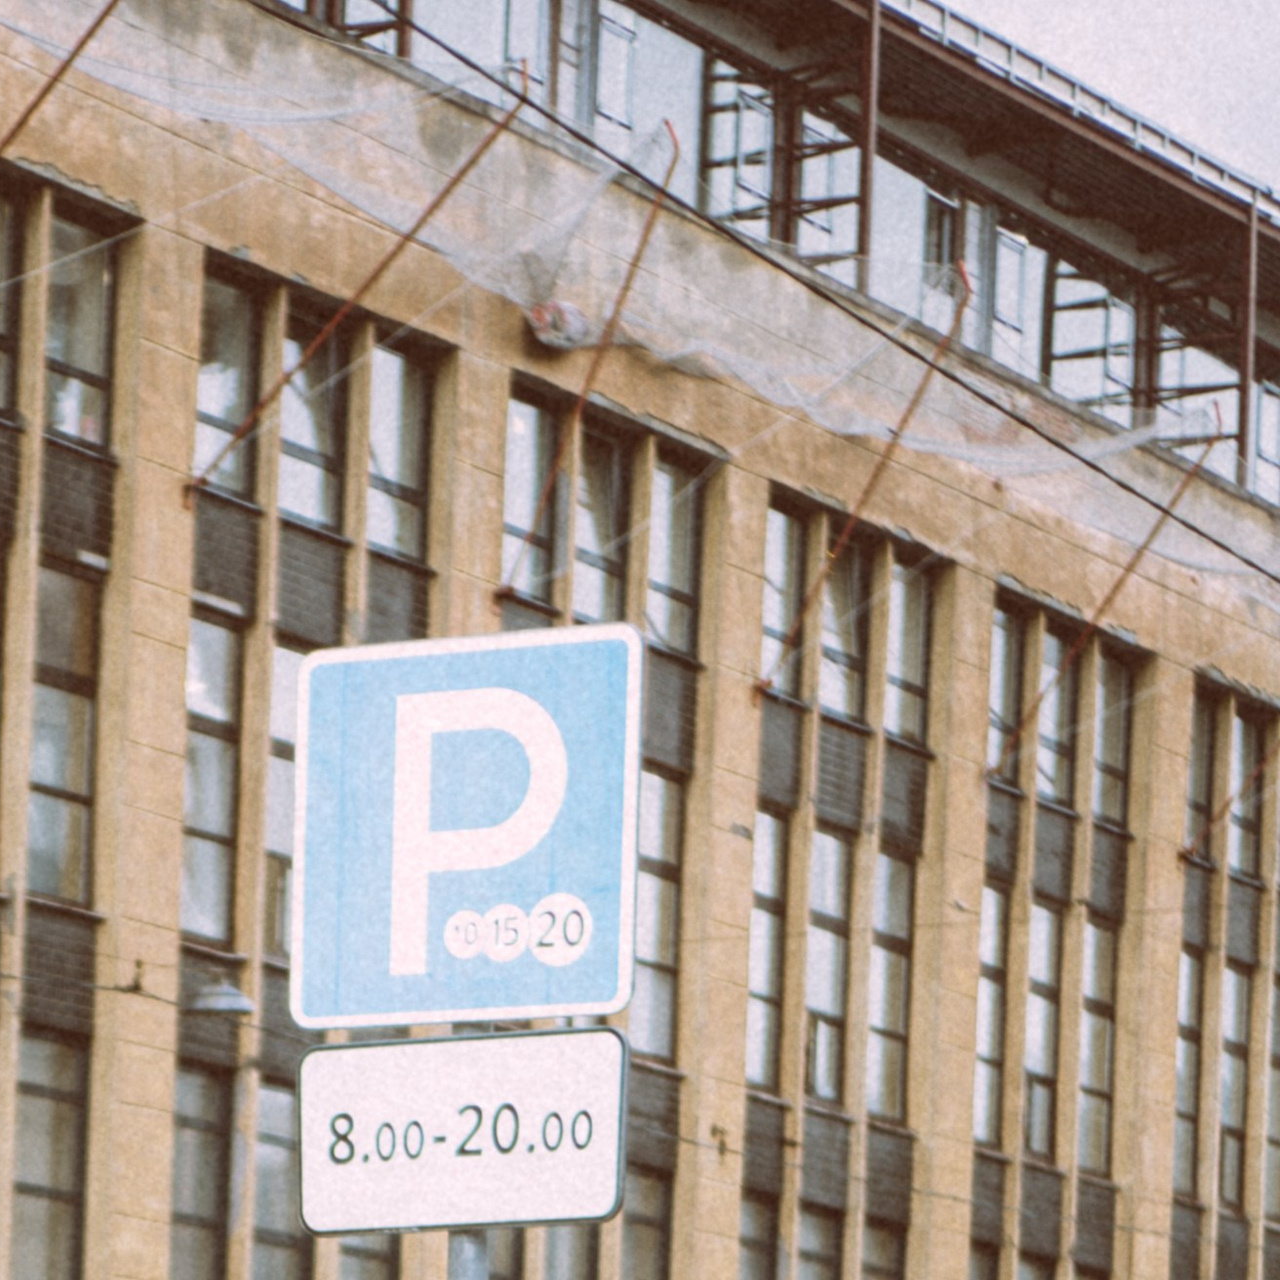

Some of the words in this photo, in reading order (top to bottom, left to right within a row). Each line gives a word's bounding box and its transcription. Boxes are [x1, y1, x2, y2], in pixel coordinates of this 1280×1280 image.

[390, 688, 569, 976] P
[493, 915, 519, 947] 15
[535, 909, 586, 948] 20
[328, 1102, 595, 1165] 8.00-20.00
